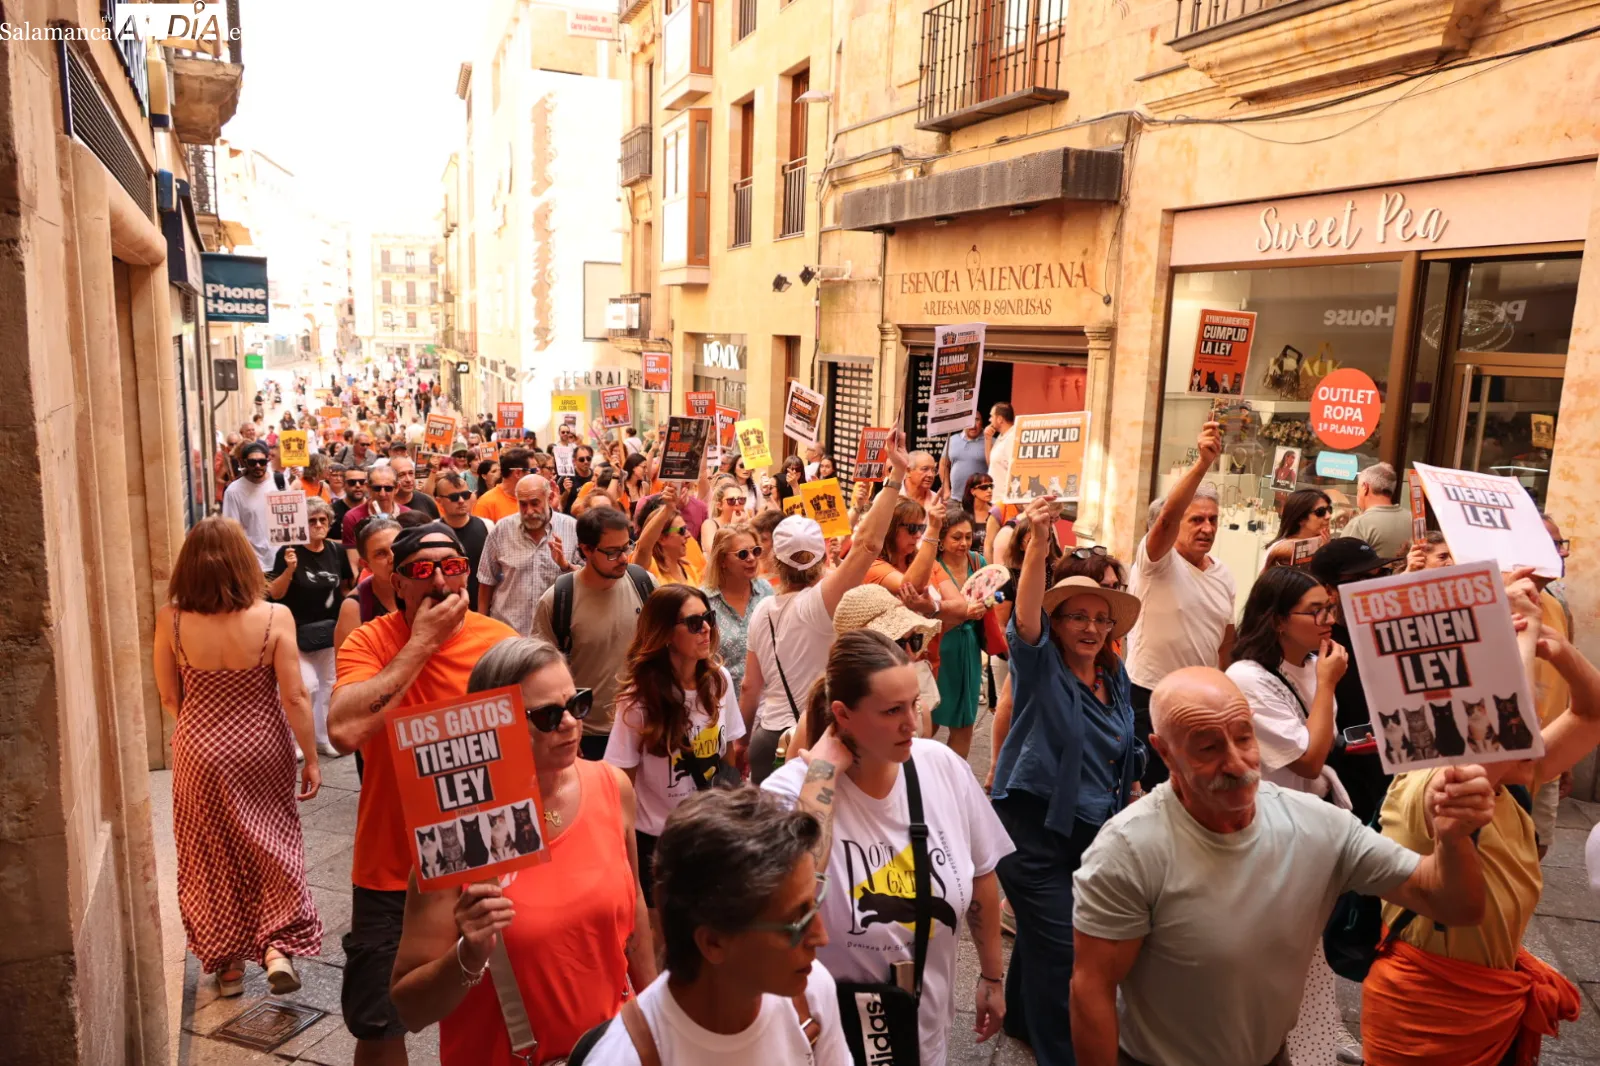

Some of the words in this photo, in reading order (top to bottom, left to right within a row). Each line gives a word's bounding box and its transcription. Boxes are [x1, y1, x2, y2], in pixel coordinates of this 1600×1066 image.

[1255, 200, 1363, 253] Sweet
[1376, 191, 1450, 244] Pea
[901, 269, 960, 294] ESENCIA
[967, 261, 1089, 291] VALENCIANA
[205, 283, 266, 300] Phone
[206, 299, 267, 315] House
[923, 299, 981, 316] ARTESANOS
[993, 297, 1052, 316] SONRISAS
[1204, 314, 1250, 327] AYUNTAMIENTOS
[1203, 325, 1248, 342] CUMPLID
[1200, 341, 1212, 354] LA
[1214, 342, 1232, 356] LEY
[1317, 386, 1376, 405] OUTLET
[694, 406, 706, 414] LEY
[1323, 405, 1363, 422] ROPA
[1020, 427, 1079, 444] CUMPLID
[1329, 423, 1366, 437] PLANTA
[866, 450, 880, 460] LEY
[1018, 445, 1034, 459] LA
[1036, 444, 1060, 458] LEY
[1443, 484, 1514, 509] TIENEN
[272, 504, 298, 514] TIENEN
[1461, 503, 1505, 528] LEY
[278, 514, 294, 524] LEY
[1352, 589, 1402, 623] LOS
[1408, 574, 1494, 614] GATOS
[1374, 608, 1476, 653] TIENEN
[1401, 648, 1460, 692] LEY
[397, 715, 440, 748] LOS
[444, 699, 514, 737] GATOS
[416, 730, 500, 775] TIENEN
[438, 767, 486, 810] LEY
